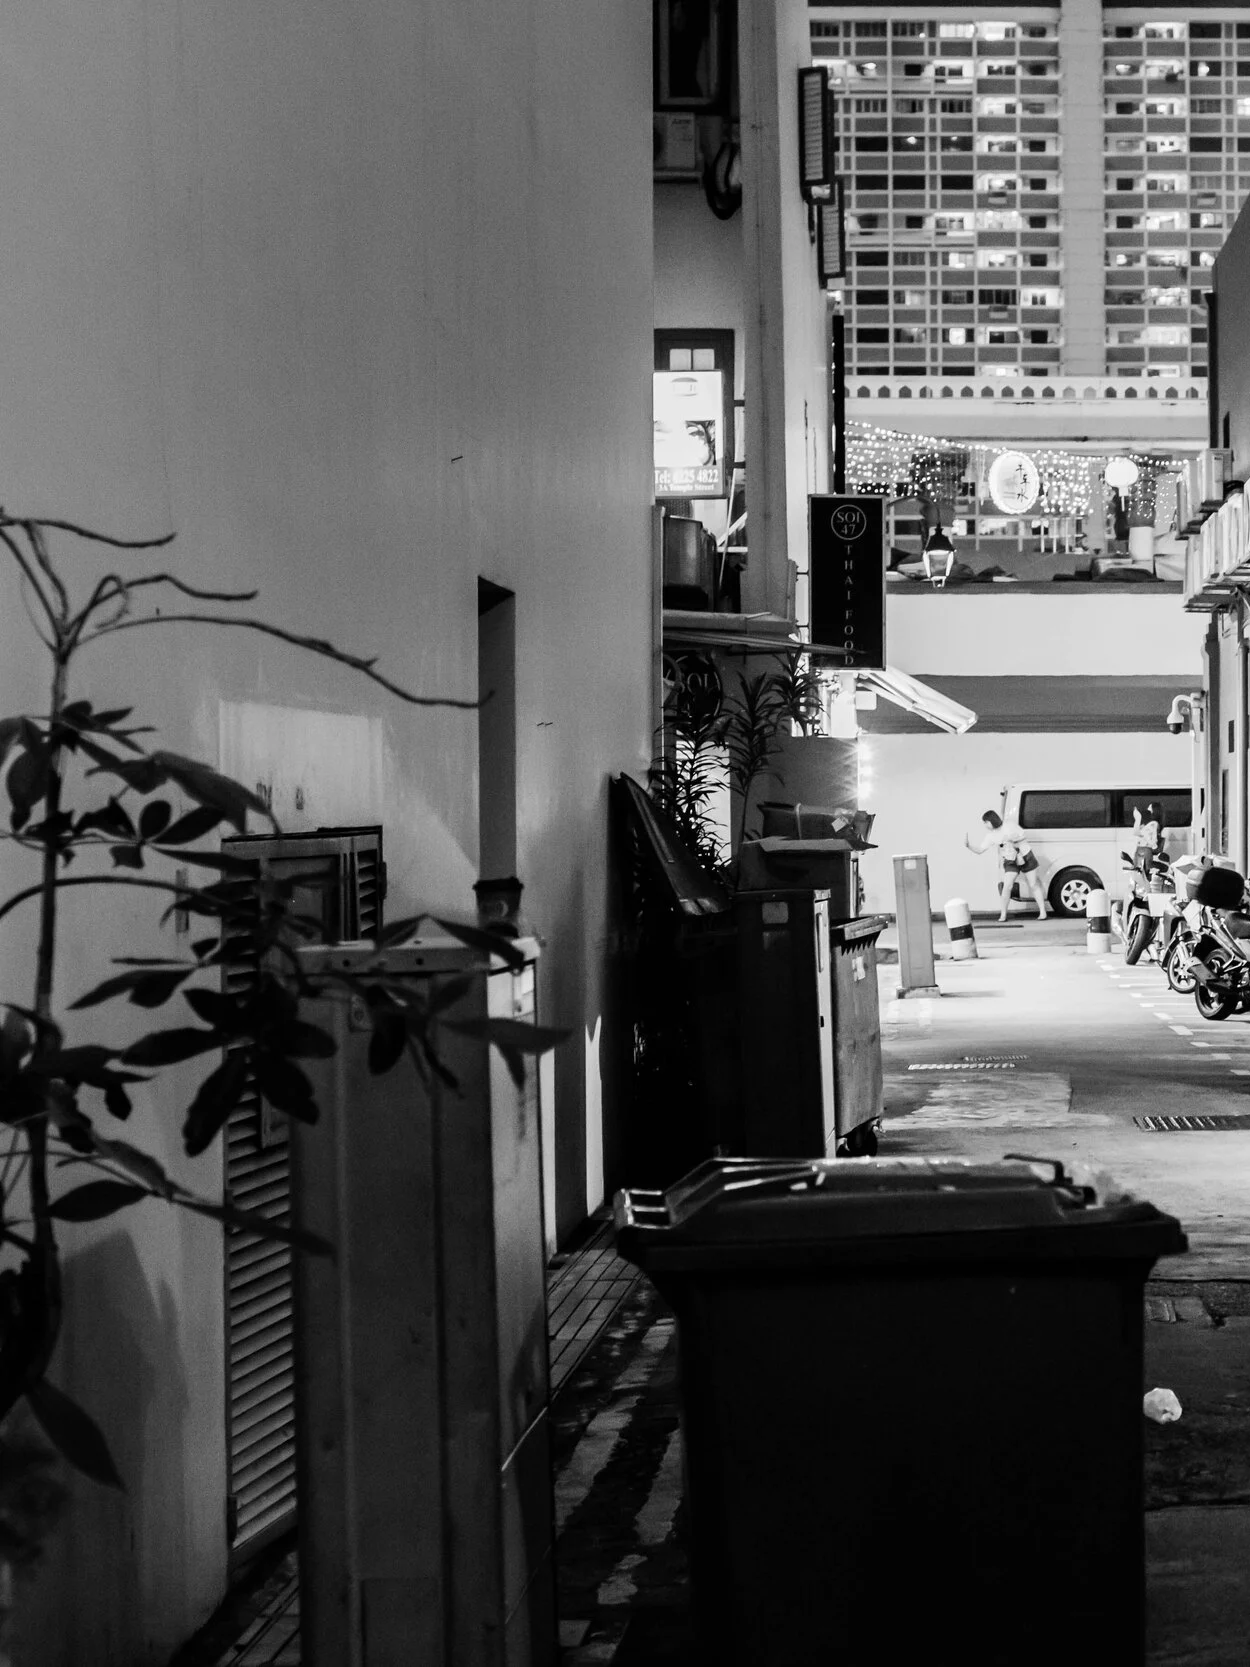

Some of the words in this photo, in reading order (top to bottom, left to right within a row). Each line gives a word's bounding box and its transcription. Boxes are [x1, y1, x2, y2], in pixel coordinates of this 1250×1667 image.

[696, 469, 719, 483] 4822
[836, 511, 861, 523] SOI
[841, 524, 856, 535] 47
[844, 545, 854, 600] THAI
[844, 610, 854, 665] FOOD
